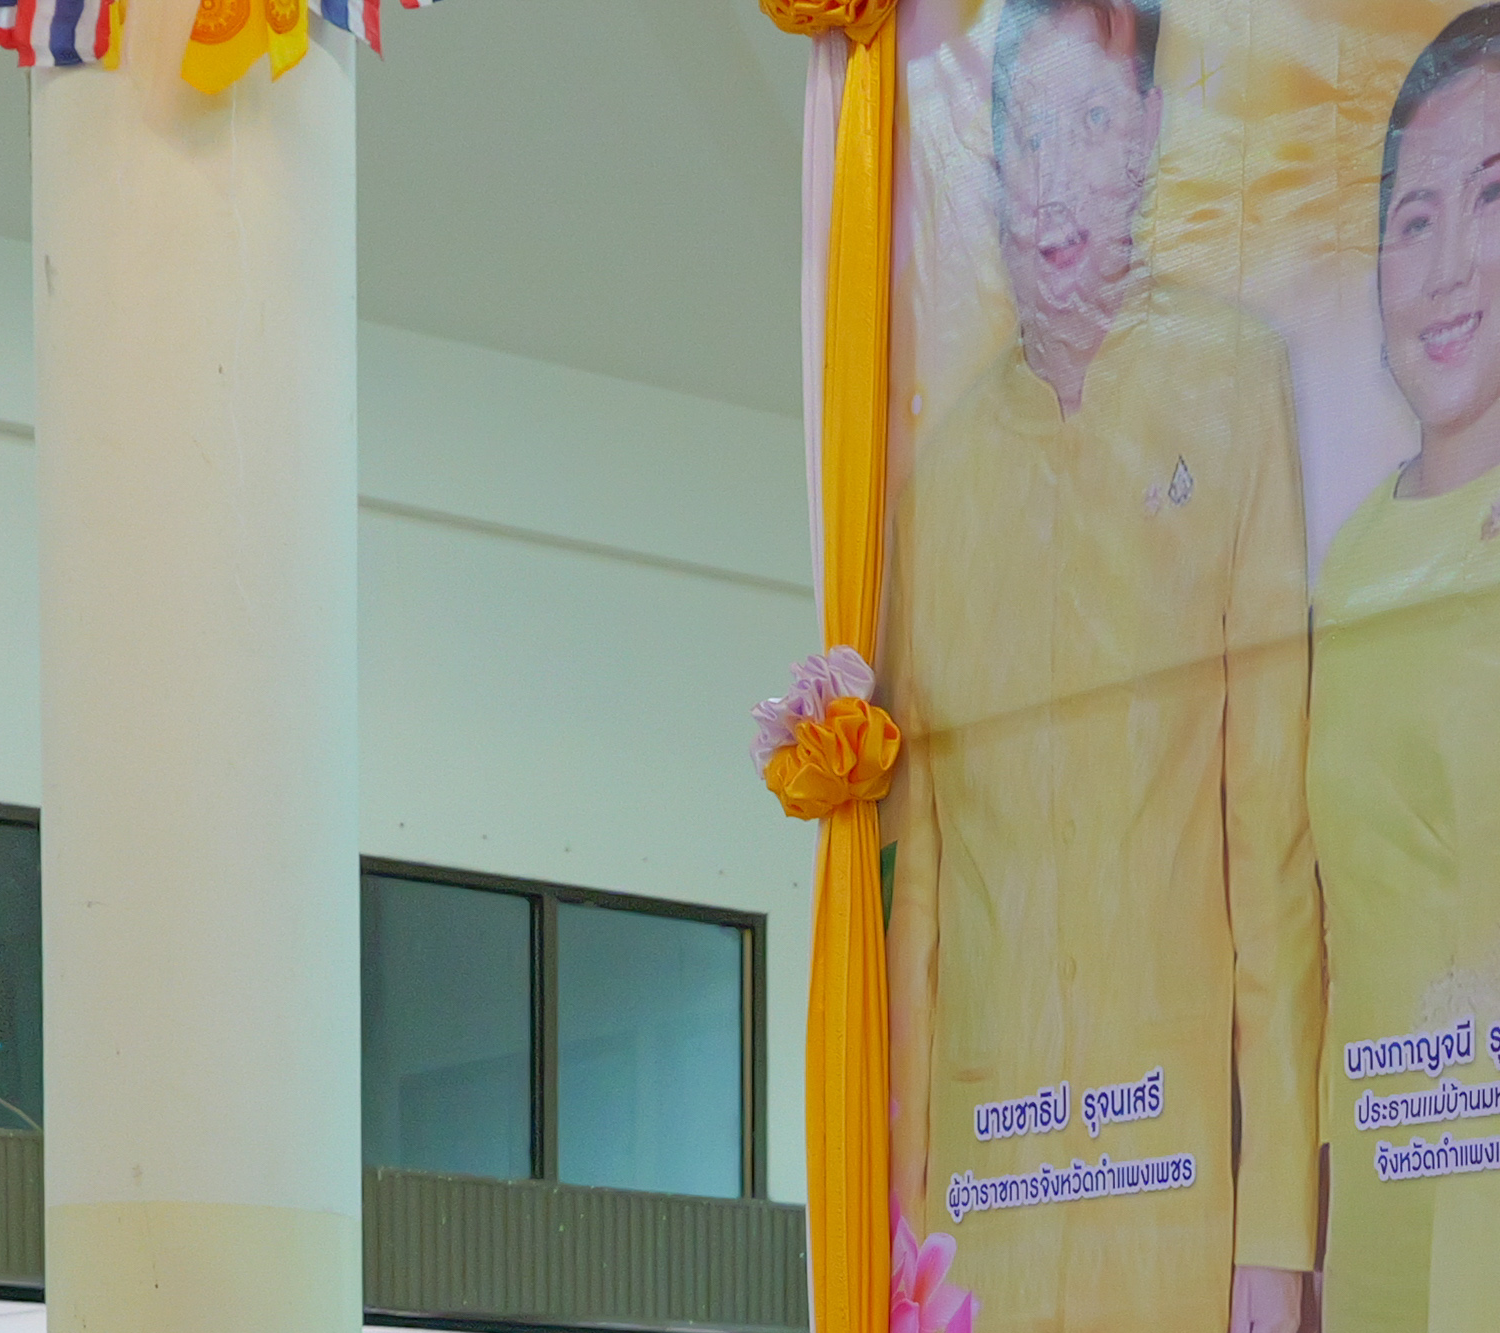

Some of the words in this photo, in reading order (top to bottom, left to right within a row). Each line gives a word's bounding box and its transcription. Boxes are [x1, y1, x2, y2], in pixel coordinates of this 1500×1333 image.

[1347, 1020, 1472, 1073] นางกาญจนี
[976, 1085, 1068, 1136] นายชาธิป
[1084, 1071, 1161, 1132] รุจนเสรี
[948, 1158, 1193, 1218] ผู้ว่าราชการจังหวัดกำแพงเพชร
